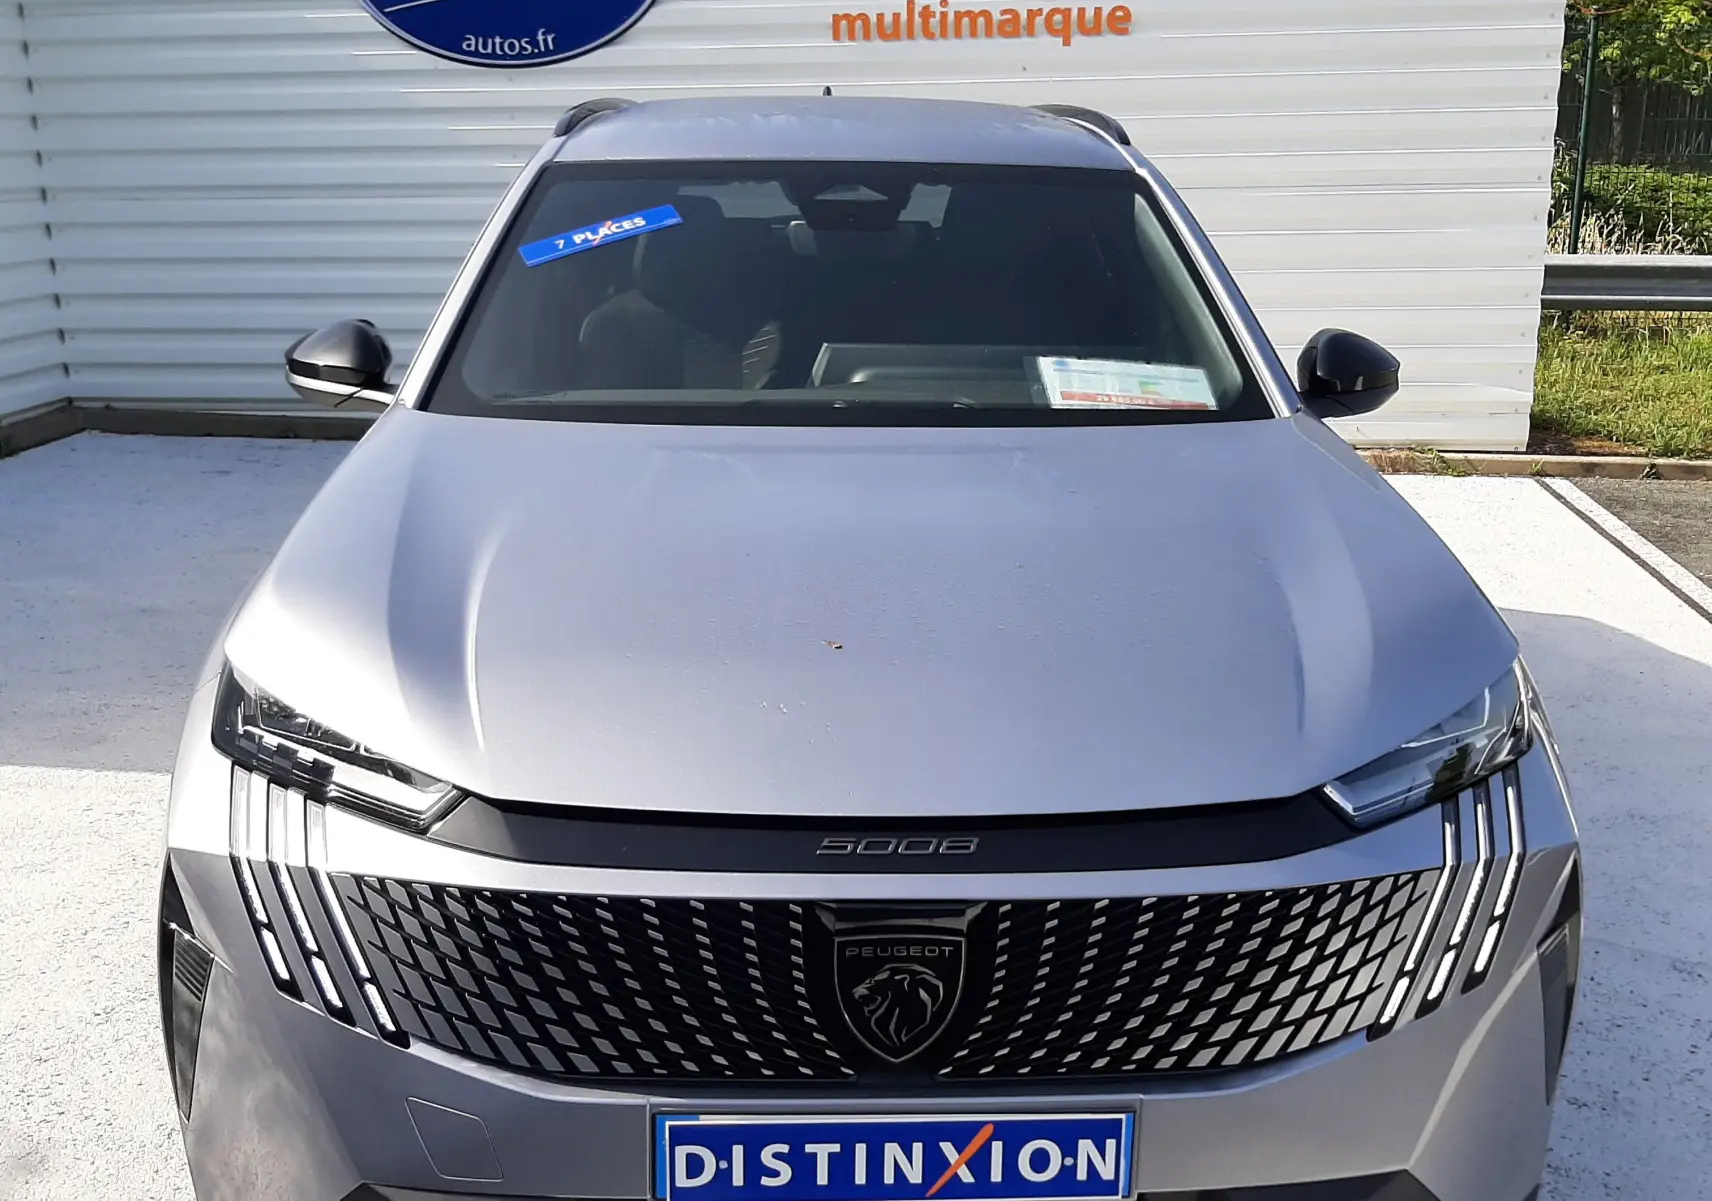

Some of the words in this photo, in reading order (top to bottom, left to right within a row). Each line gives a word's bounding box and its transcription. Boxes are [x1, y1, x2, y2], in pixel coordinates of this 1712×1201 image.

[831, 0, 1132, 47] multimarque
[461, 28, 556, 56] autos.fr
[554, 239, 565, 250] 7
[572, 217, 647, 245] PLACES
[816, 837, 980, 855] 5008
[845, 946, 954, 958] PEUGEOT
